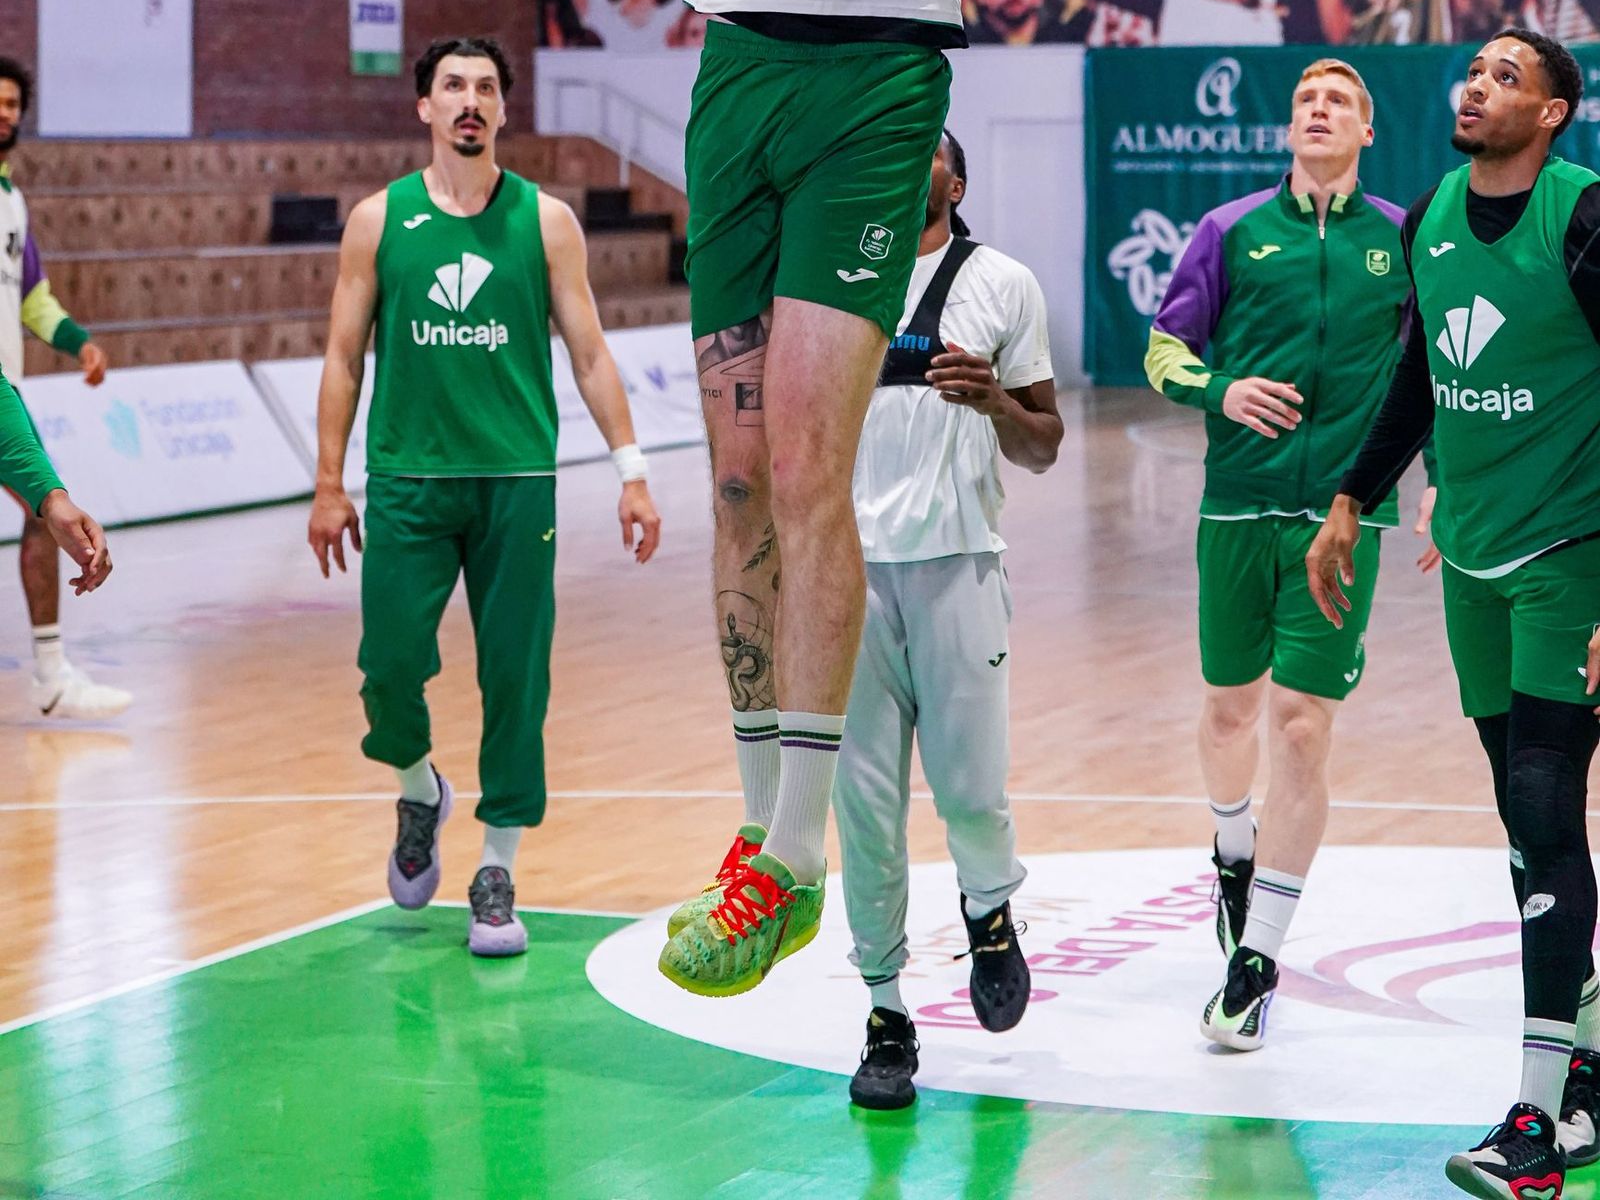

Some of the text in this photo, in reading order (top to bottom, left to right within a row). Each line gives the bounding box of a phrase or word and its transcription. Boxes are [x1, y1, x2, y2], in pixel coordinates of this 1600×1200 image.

[411, 318, 509, 352] Unicaja
[1431, 374, 1535, 421] nicaja
[1084, 872, 1219, 932] OSTA
